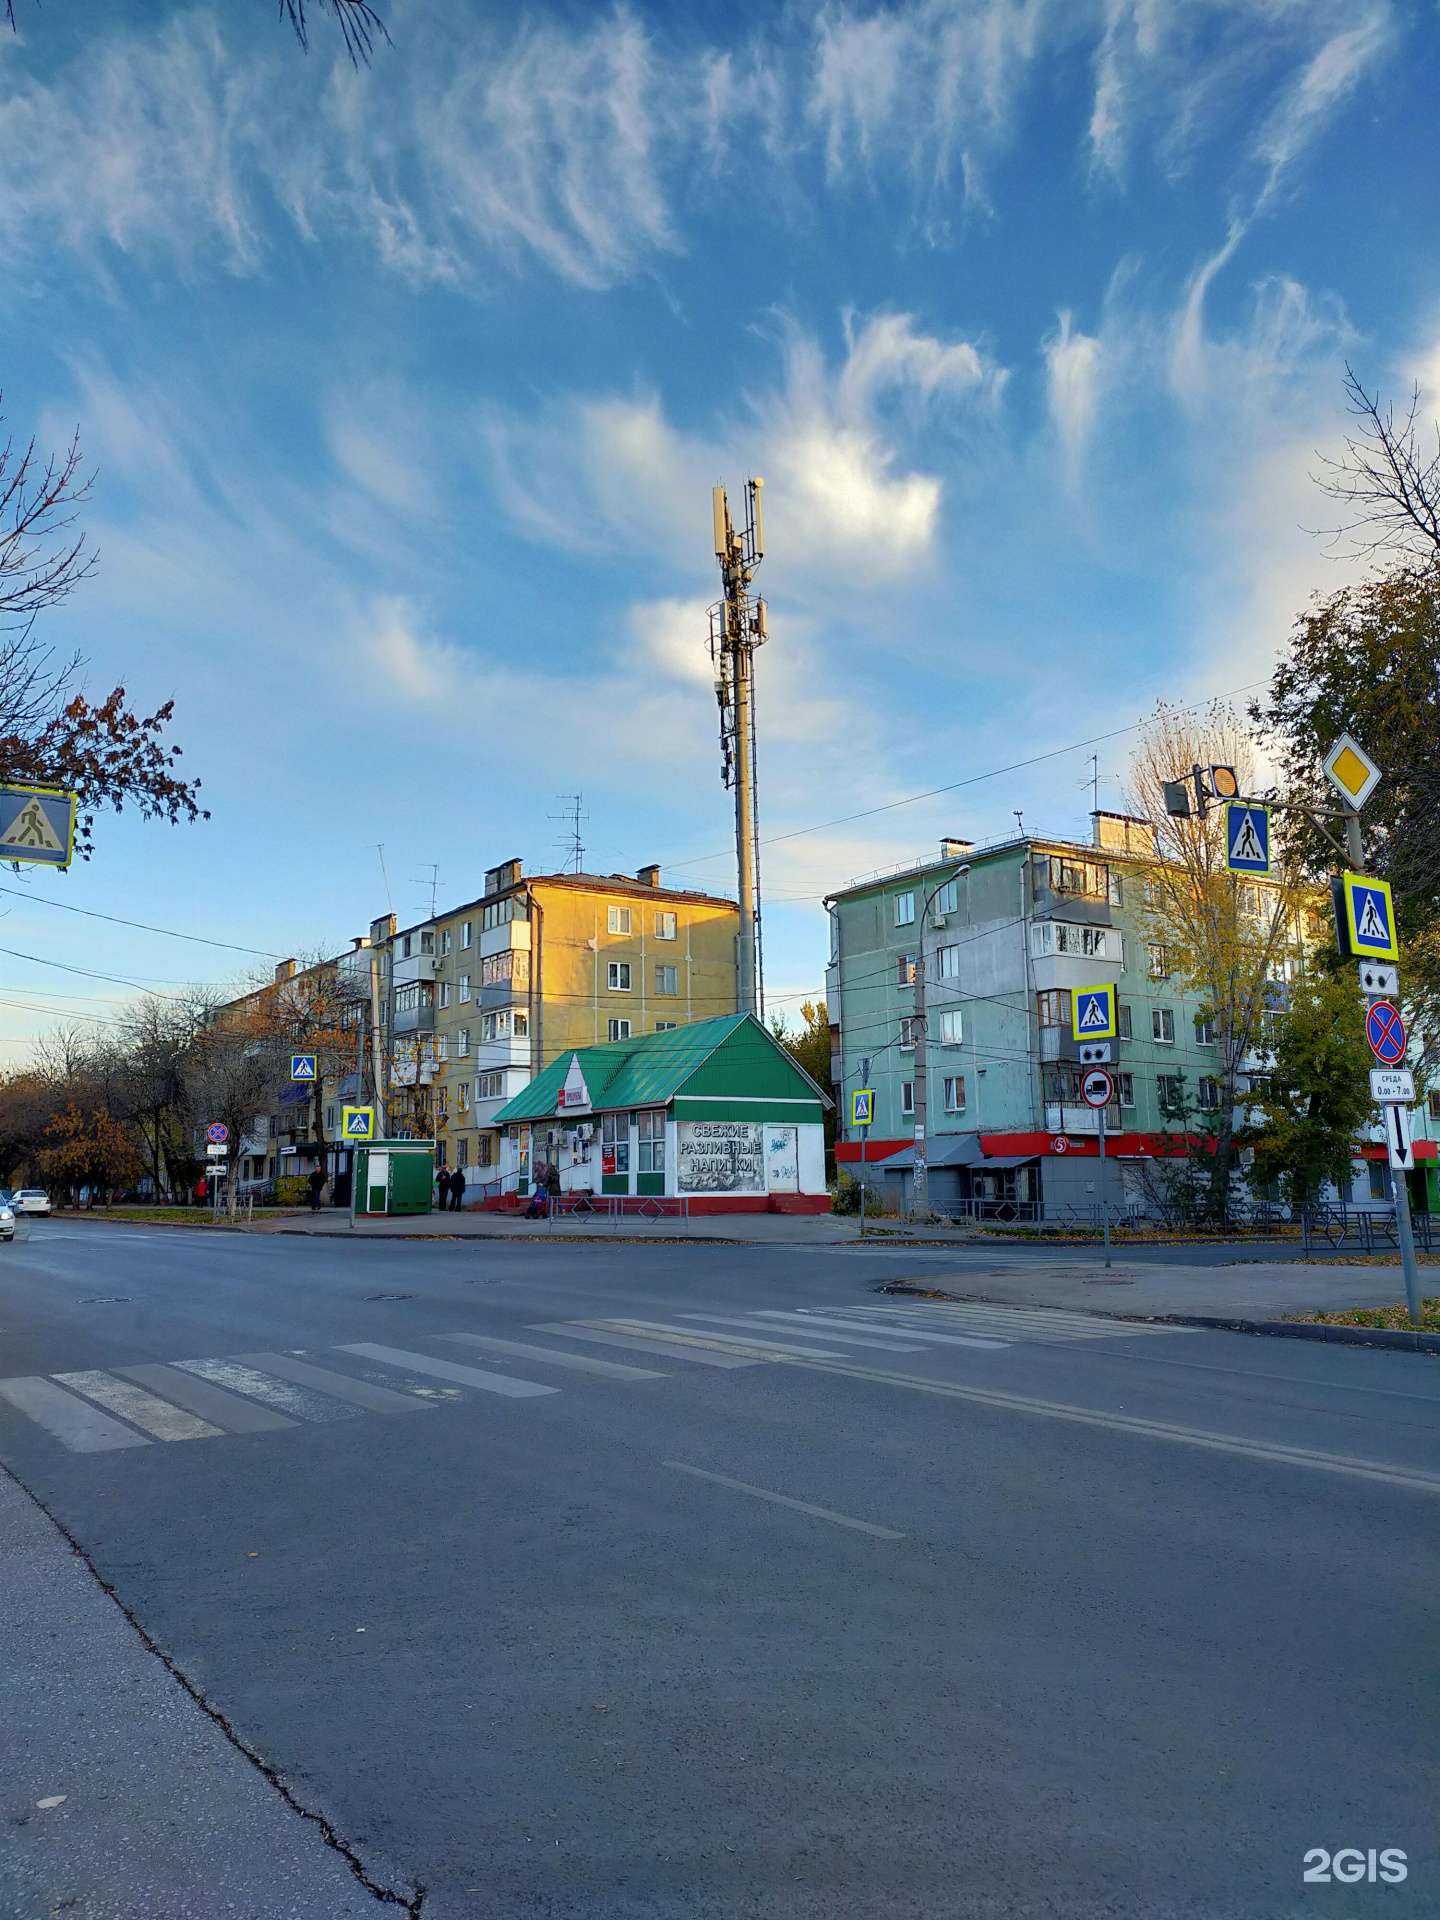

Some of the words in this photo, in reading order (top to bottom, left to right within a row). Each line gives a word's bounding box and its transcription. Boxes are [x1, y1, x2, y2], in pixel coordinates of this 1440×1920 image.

[1381, 1075, 1402, 1083] СРЕДА
[692, 1124, 749, 1138] СВЕЖИЕ
[680, 1141, 762, 1155] РАЗЛИВНЫЕ
[691, 1159, 752, 1172] НАПИТКИ
